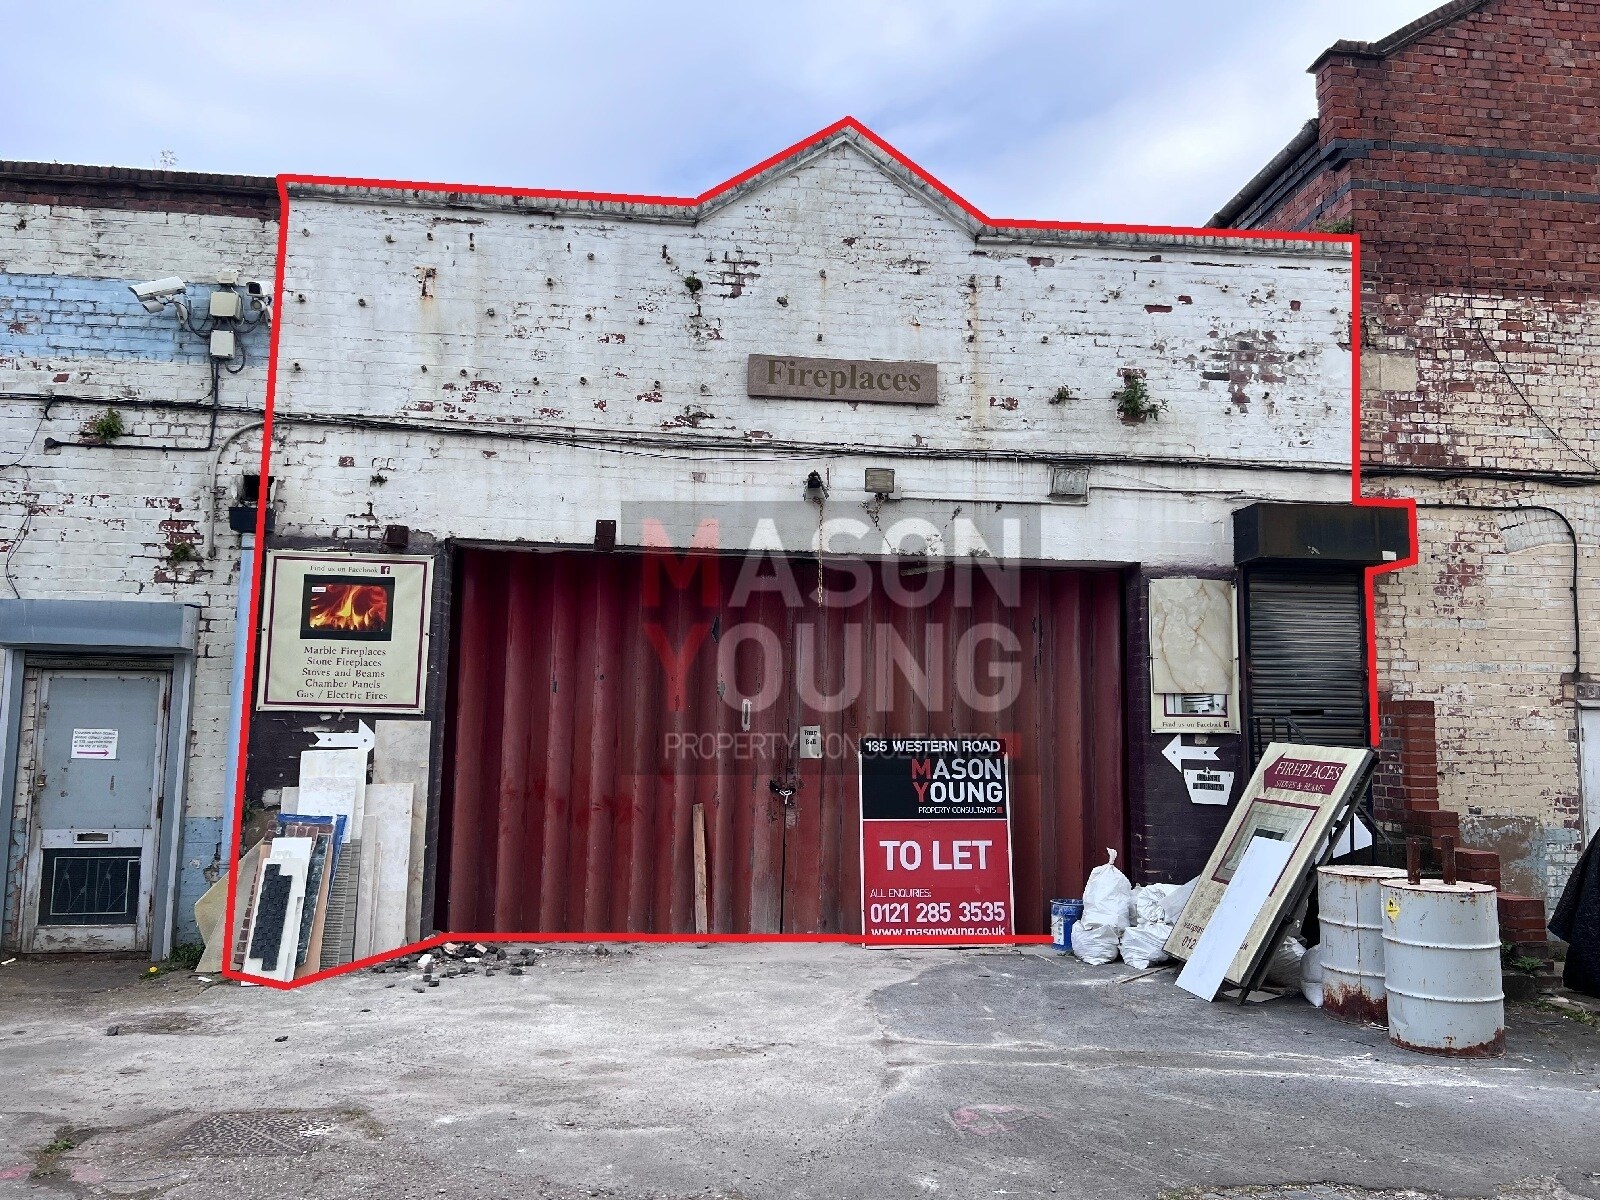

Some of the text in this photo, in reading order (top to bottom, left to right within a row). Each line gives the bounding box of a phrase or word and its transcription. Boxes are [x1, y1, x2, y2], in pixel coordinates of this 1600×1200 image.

[766, 359, 921, 396] Fireplaces
[303, 646, 387, 657] Marble Fireplaces
[306, 657, 382, 668] Stone Fireplaces
[302, 667, 385, 678] Stoves and Beams
[305, 678, 381, 688] Chamber Panels
[296, 690, 314, 698] Gas
[326, 690, 362, 699] Electric
[365, 691, 388, 700] Fires
[892, 740, 959, 752] WESTERN
[962, 740, 1001, 752] ROAD
[911, 758, 1002, 780] MASON
[1274, 761, 1343, 781] FIREPLACES
[1274, 779, 1297, 789] STOVES
[1303, 782, 1326, 792] BEAMS
[912, 781, 1003, 803] YOUNG
[918, 806, 997, 814] PROPERTY CONSULTANTS
[879, 840, 993, 871] TO LET
[870, 888, 932, 898] ALL ENQUIRIES:
[870, 901, 1006, 923] 0121 285 3535
